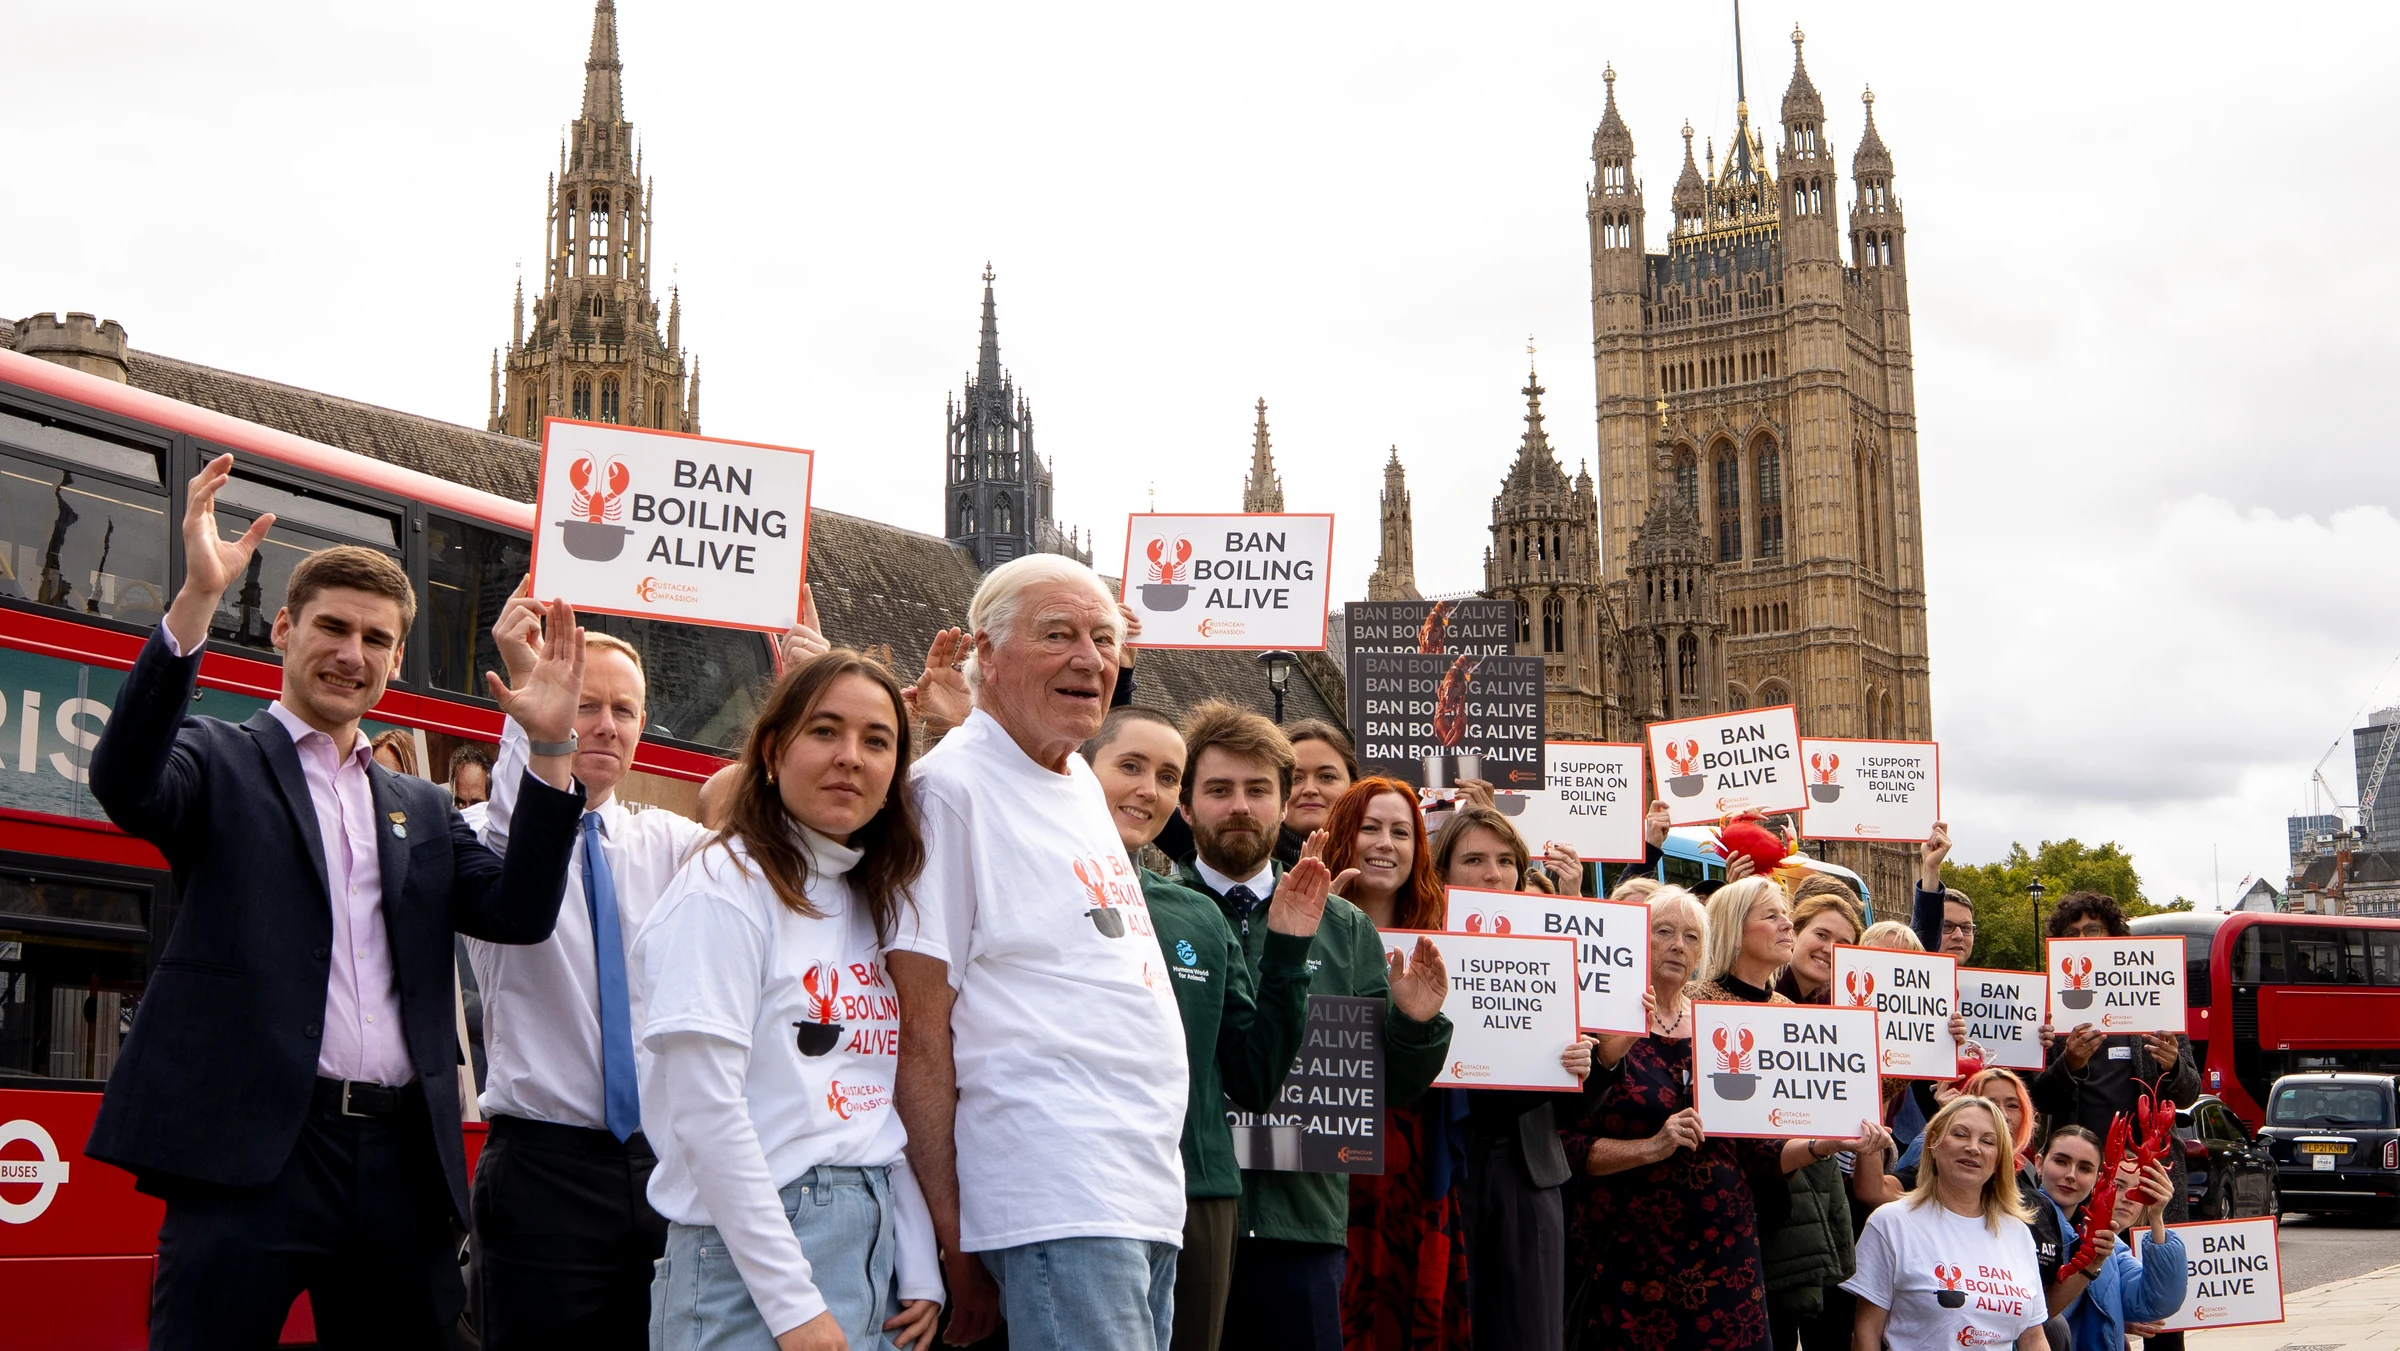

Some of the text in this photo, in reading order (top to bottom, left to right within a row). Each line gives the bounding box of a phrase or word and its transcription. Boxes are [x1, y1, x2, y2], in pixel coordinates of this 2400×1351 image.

[673, 459, 752, 495] BAN
[632, 493, 787, 539] BOILING
[1225, 532, 1286, 552] BAN
[646, 536, 756, 574] ALIVE
[1194, 560, 1314, 581] BOILING
[643, 576, 698, 592] CRUSTACEAN
[642, 588, 698, 603] COMPASSION
[1205, 588, 1290, 609] ALIVE
[1353, 606, 1507, 620] BAN BOILG ALIVE
[1354, 624, 1507, 639] BAN BOIG ALIVE
[1366, 658, 1536, 676] BAN BOILG ALIVE
[1366, 678, 1536, 696] BAN BOIG ALIVE
[1366, 700, 1403, 714] BAN
[1486, 703, 1537, 718] ALIVE
[1366, 722, 1403, 736] BAN
[1486, 725, 1537, 739] ALIVE
[1720, 724, 1765, 745] BAN
[1366, 744, 1403, 759] BAN
[1486, 747, 1537, 762] ALIVE
[1703, 743, 1790, 770] BOILING
[1862, 757, 1921, 768] I SUPPORT
[1553, 762, 1624, 774] I SUPPORT
[1856, 769, 1925, 780] THE BAN ON
[1545, 776, 1628, 788] THE BAN ON
[1717, 767, 1777, 790] ALIVE
[1869, 781, 1915, 792] BOILING
[1561, 791, 1616, 802] BOILING
[1876, 793, 1908, 803] ALIVE
[1569, 805, 1608, 816] ALIVE
[1544, 912, 1604, 937] BAN
[1461, 958, 1550, 976] I SUPPORT
[2114, 951, 2154, 966] BAN
[849, 962, 886, 988] BAN
[1894, 968, 1930, 989] BAN
[2095, 971, 2175, 986] BOILING
[1451, 977, 1557, 995] THE BAN ON
[1981, 983, 2019, 1000] BAN
[840, 995, 898, 1021] BOILIN
[1472, 996, 1543, 1012] BOILING
[1876, 993, 1947, 1017] BOILING
[2105, 991, 2160, 1007] ALIVE
[1309, 1003, 1374, 1024] ALIVE
[1961, 1002, 2037, 1022] BOILING
[1483, 1014, 1532, 1030] ALIVE
[1308, 1029, 1374, 1050] ALIVE
[1783, 1023, 1838, 1044] BAN
[1885, 1021, 1935, 1043] ALIVE
[1969, 1023, 2022, 1041] ALIVE
[844, 1029, 897, 1055] ALIVE
[1308, 1057, 1374, 1079] ALIVE
[1758, 1050, 1866, 1073] BOILING
[1308, 1086, 1374, 1107] ALIVE
[1772, 1078, 1847, 1101] ALIVE
[1308, 1115, 1374, 1137] ALIVE
[1, 1166, 38, 1177] BUSES
[2202, 1234, 2245, 1253] BAN
[1978, 1265, 2013, 1282] BAN
[2188, 1255, 2268, 1277] BOILING
[1965, 1279, 2032, 1300] BOILING
[2196, 1278, 2255, 1298] ALIVE
[1976, 1296, 2023, 1316] ALIVE
